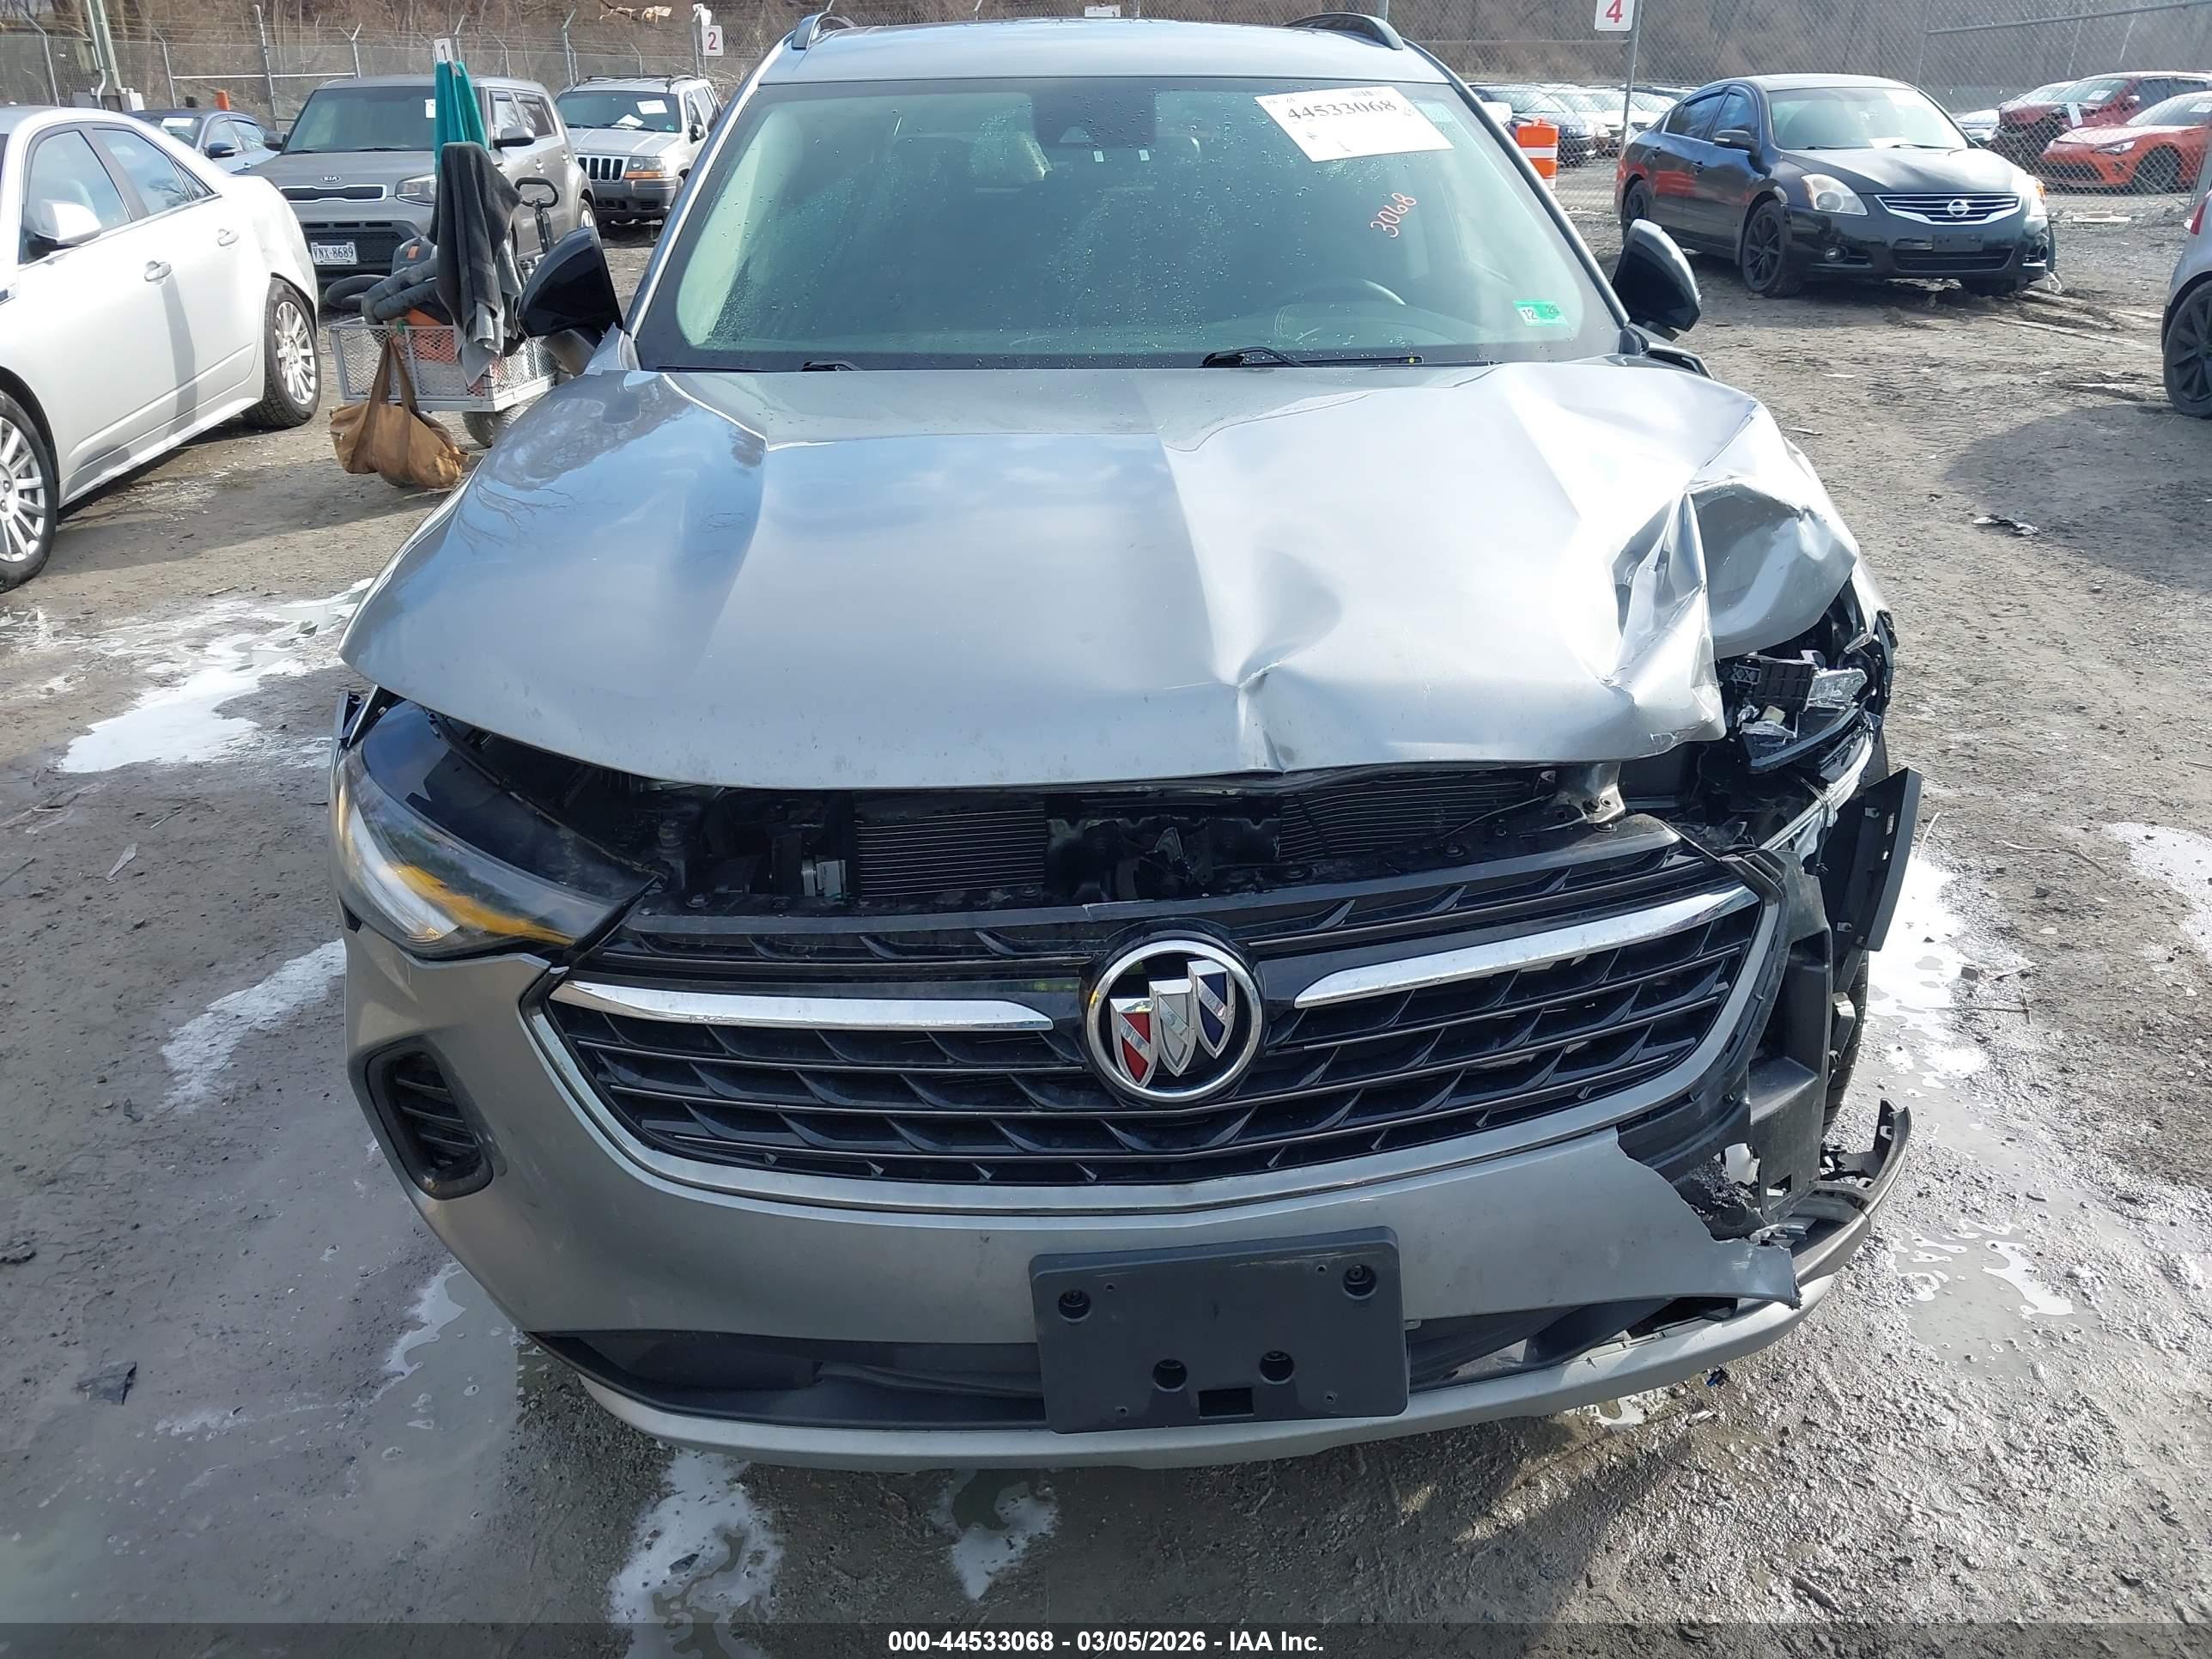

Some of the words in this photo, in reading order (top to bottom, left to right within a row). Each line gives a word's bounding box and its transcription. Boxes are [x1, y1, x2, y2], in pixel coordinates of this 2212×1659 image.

[1606, 0, 1623, 23] 4
[708, 31, 718, 51] 2
[440, 43, 448, 61] 1
[1287, 99, 1397, 120] 44533068
[1370, 192, 1417, 238] 3068
[313, 246, 354, 259] VNX-8689
[1522, 309, 1538, 319] 12
